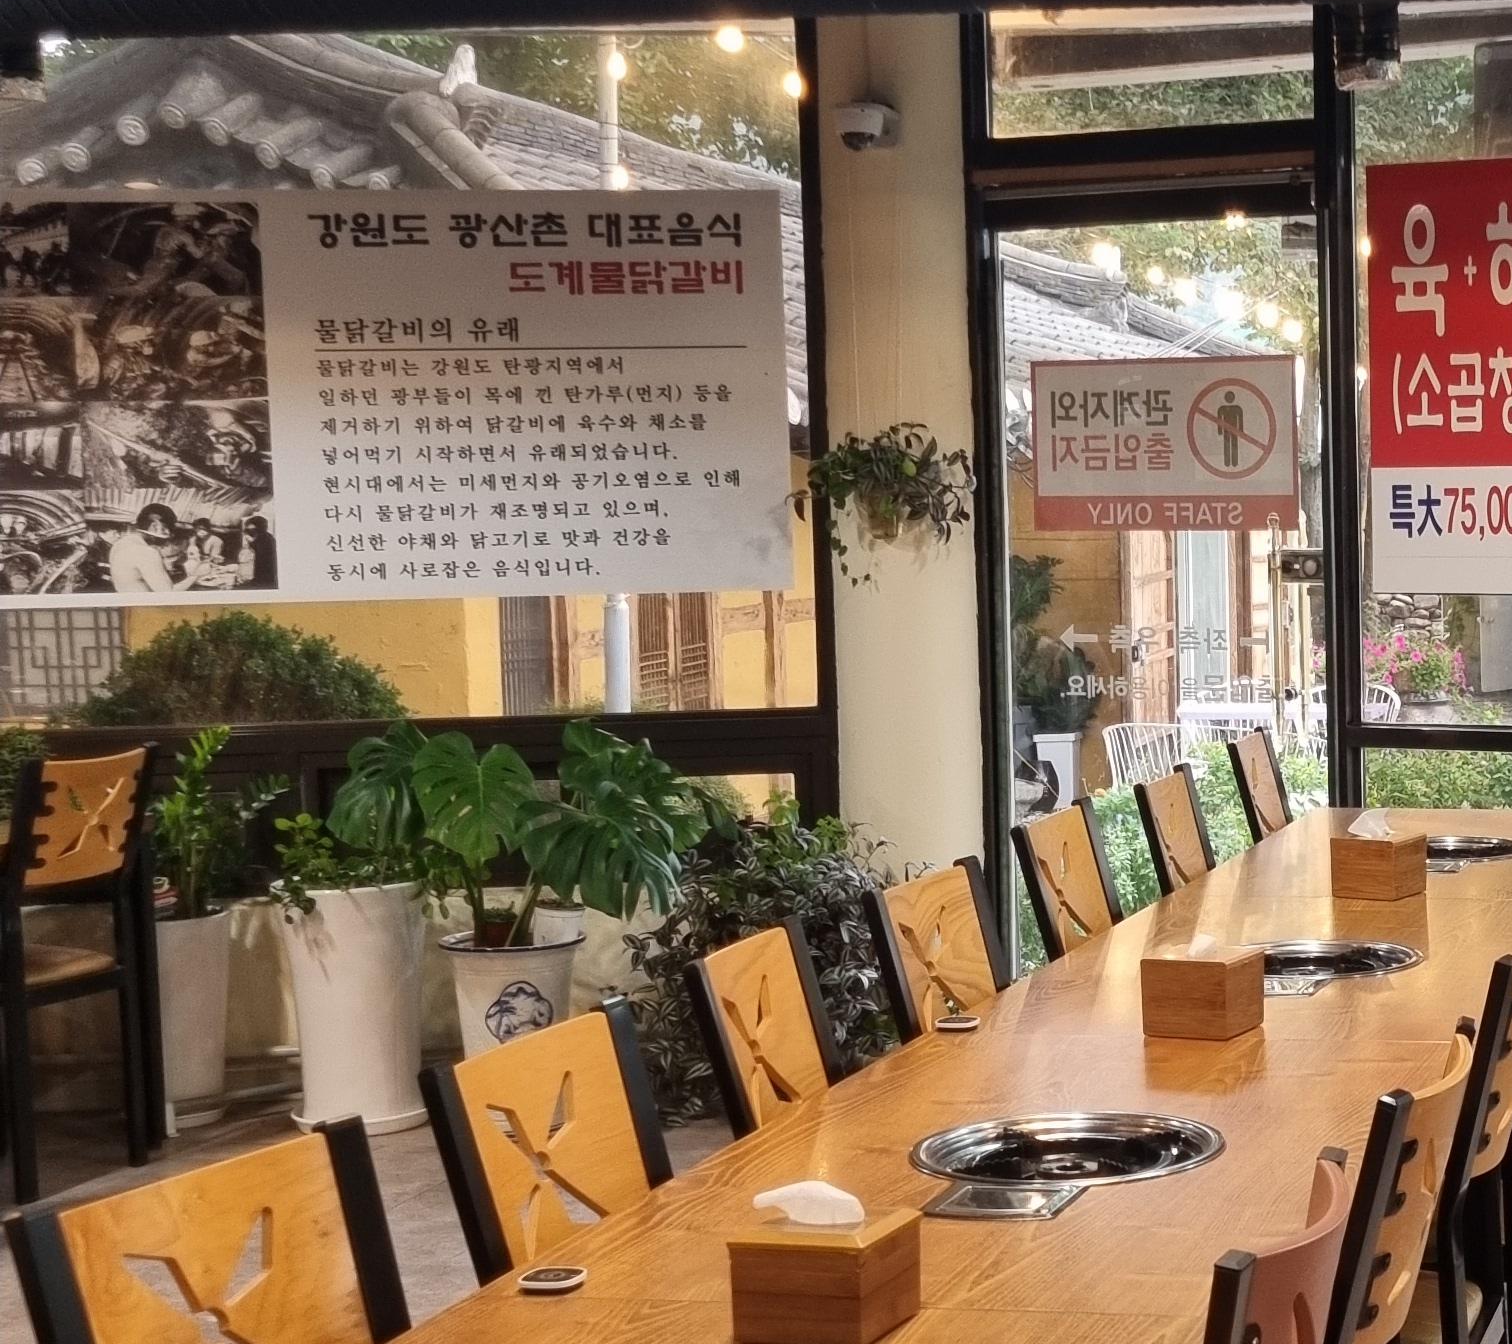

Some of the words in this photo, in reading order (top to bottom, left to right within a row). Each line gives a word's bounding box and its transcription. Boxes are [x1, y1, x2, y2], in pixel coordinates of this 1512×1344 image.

[306, 212, 431, 250] 강원도
[448, 211, 569, 250] 광산촌
[587, 211, 743, 249] 대표음식
[508, 259, 745, 296] 도계물닭갈비
[314, 317, 453, 345] 물닭갈비의
[467, 316, 520, 344] 유래
[316, 359, 420, 378] 물닭갈비는
[430, 358, 493, 377] 강원도
[503, 356, 625, 376] 탄광지역에서
[318, 389, 379, 407] 일하던
[390, 387, 473, 406] 광부들이
[484, 386, 524, 405] 목에
[564, 385, 684, 404] 탄가루(먼지)
[693, 384, 733, 403] 등을
[320, 417, 401, 436] 제거하기
[413, 416, 474, 435] 위하여
[484, 415, 566, 435] 닭갈비에
[577, 414, 639, 433] 육수와
[648, 413, 708, 432] 채소를
[321, 445, 402, 466] 넣어먹기
[415, 444, 517, 464] 시작하면서
[528, 442, 679, 462] 유래되었습니다.
[322, 474, 448, 494] 현시대에서는
[459, 472, 561, 492] 미세먼지와
[571, 471, 693, 491] 공기오염으로
[703, 469, 741, 488] 인해
[324, 504, 363, 524] 다시
[375, 503, 479, 523] 물닭갈비가
[489, 501, 591, 520] 재조명되고
[326, 533, 387, 553] 신선한
[397, 532, 459, 551] 야채와
[470, 530, 551, 550] 닭고기로
[562, 529, 601, 548] 맛과
[612, 527, 672, 547] 건강을
[327, 562, 387, 582] 동시에
[399, 560, 481, 580] 사로잡은
[492, 558, 601, 578] 음식입니다.
